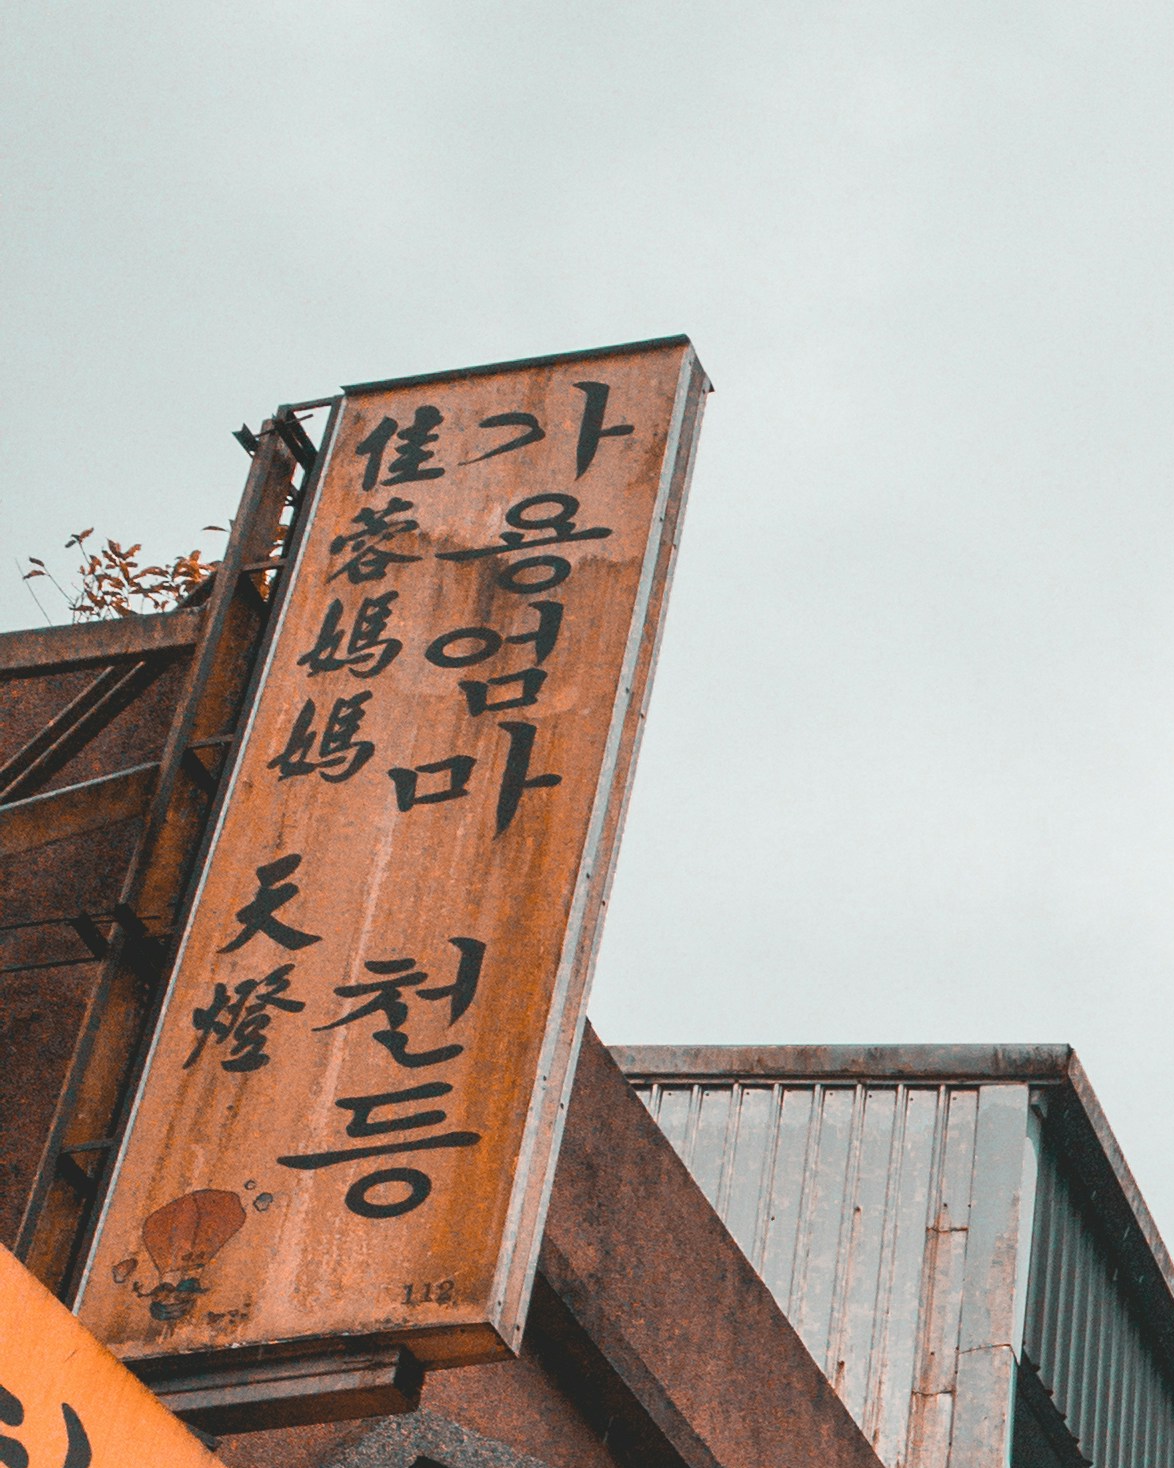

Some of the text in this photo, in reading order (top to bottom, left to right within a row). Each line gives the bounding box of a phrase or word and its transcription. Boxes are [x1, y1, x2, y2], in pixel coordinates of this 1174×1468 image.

[182, 404, 446, 1073] 佳蓉媽媽 天燈
[277, 936, 486, 1219] 천등
